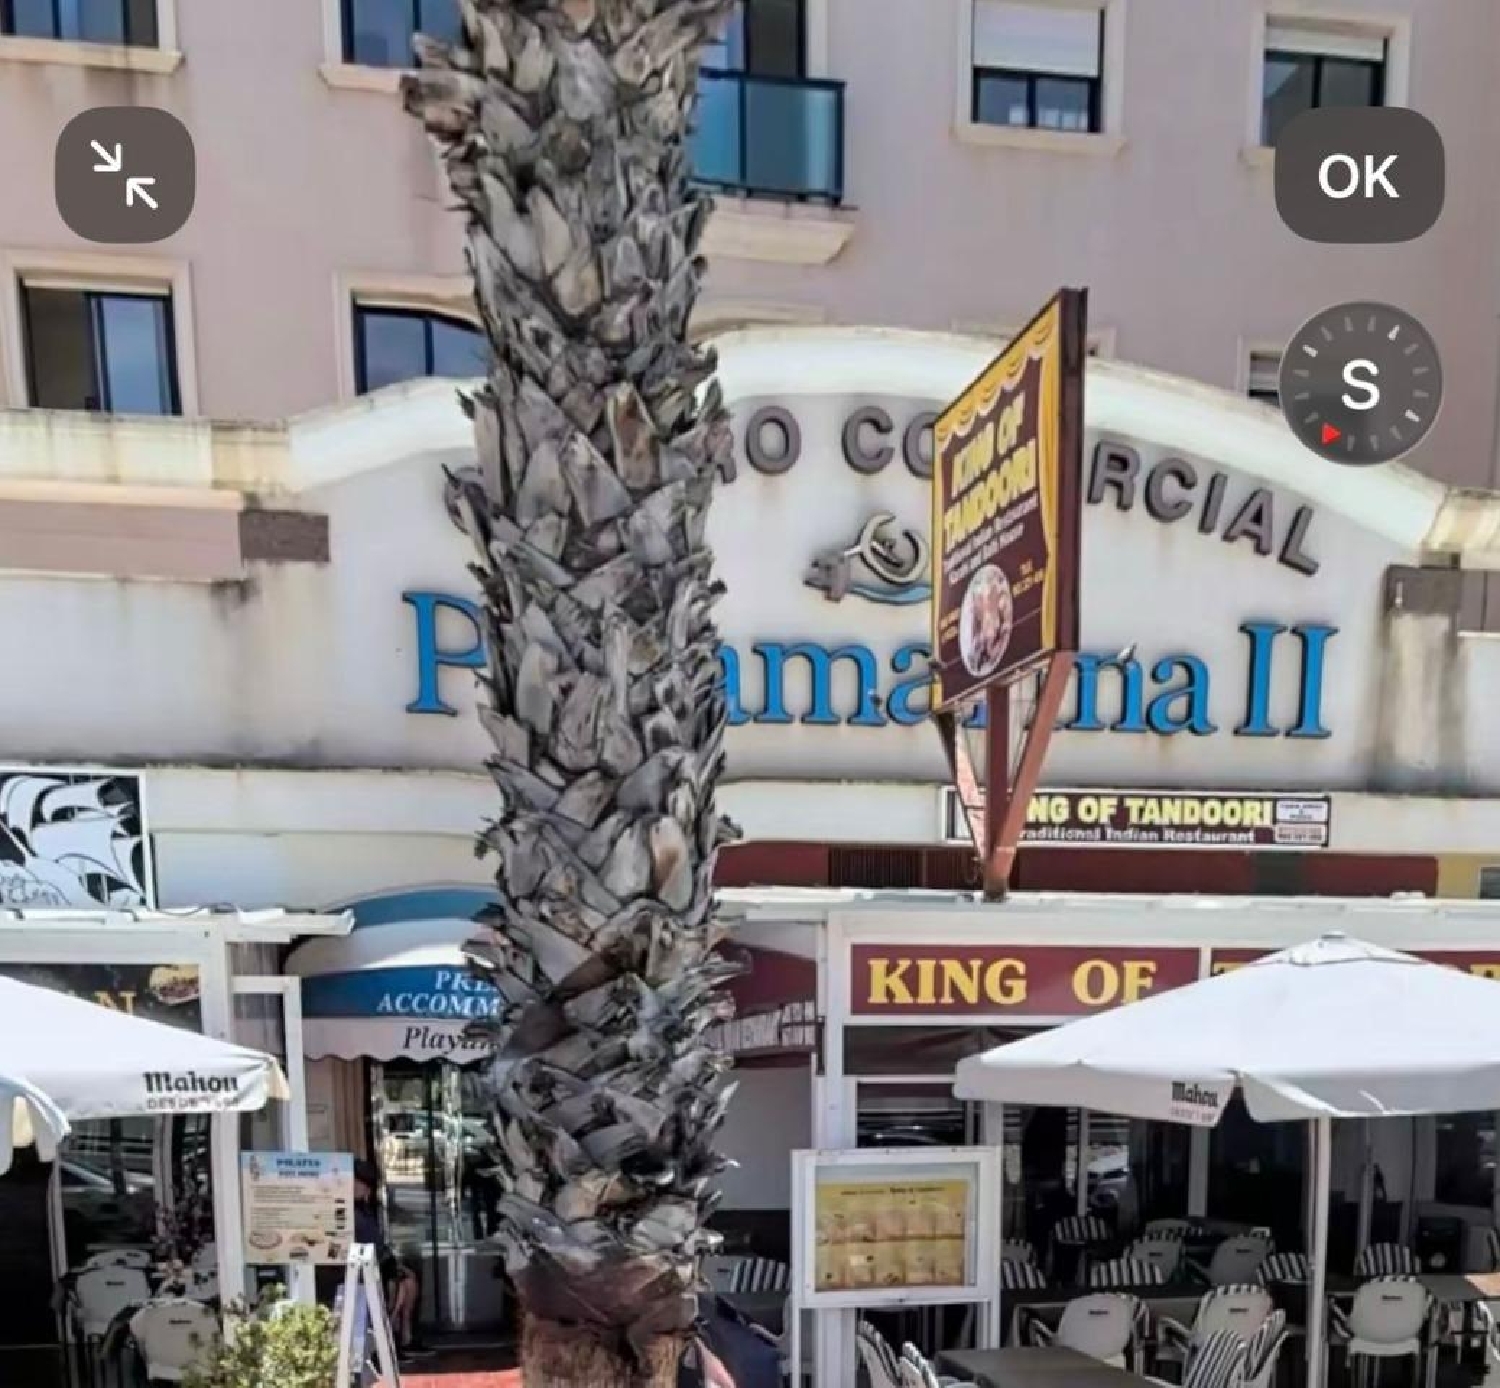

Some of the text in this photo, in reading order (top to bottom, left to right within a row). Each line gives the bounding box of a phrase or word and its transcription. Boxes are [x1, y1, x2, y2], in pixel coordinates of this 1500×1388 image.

[997, 391, 1026, 456] OF
[840, 405, 1321, 577] CORCIAL
[944, 437, 1037, 554] TANDOORI
[1019, 827, 1101, 840] raditional
[1026, 795, 1070, 824] NG
[1078, 796, 1118, 824] OF
[1124, 797, 1273, 826] TANDOORI
[376, 992, 501, 1016] ACCOMM
[867, 957, 1158, 1006] KING OF
